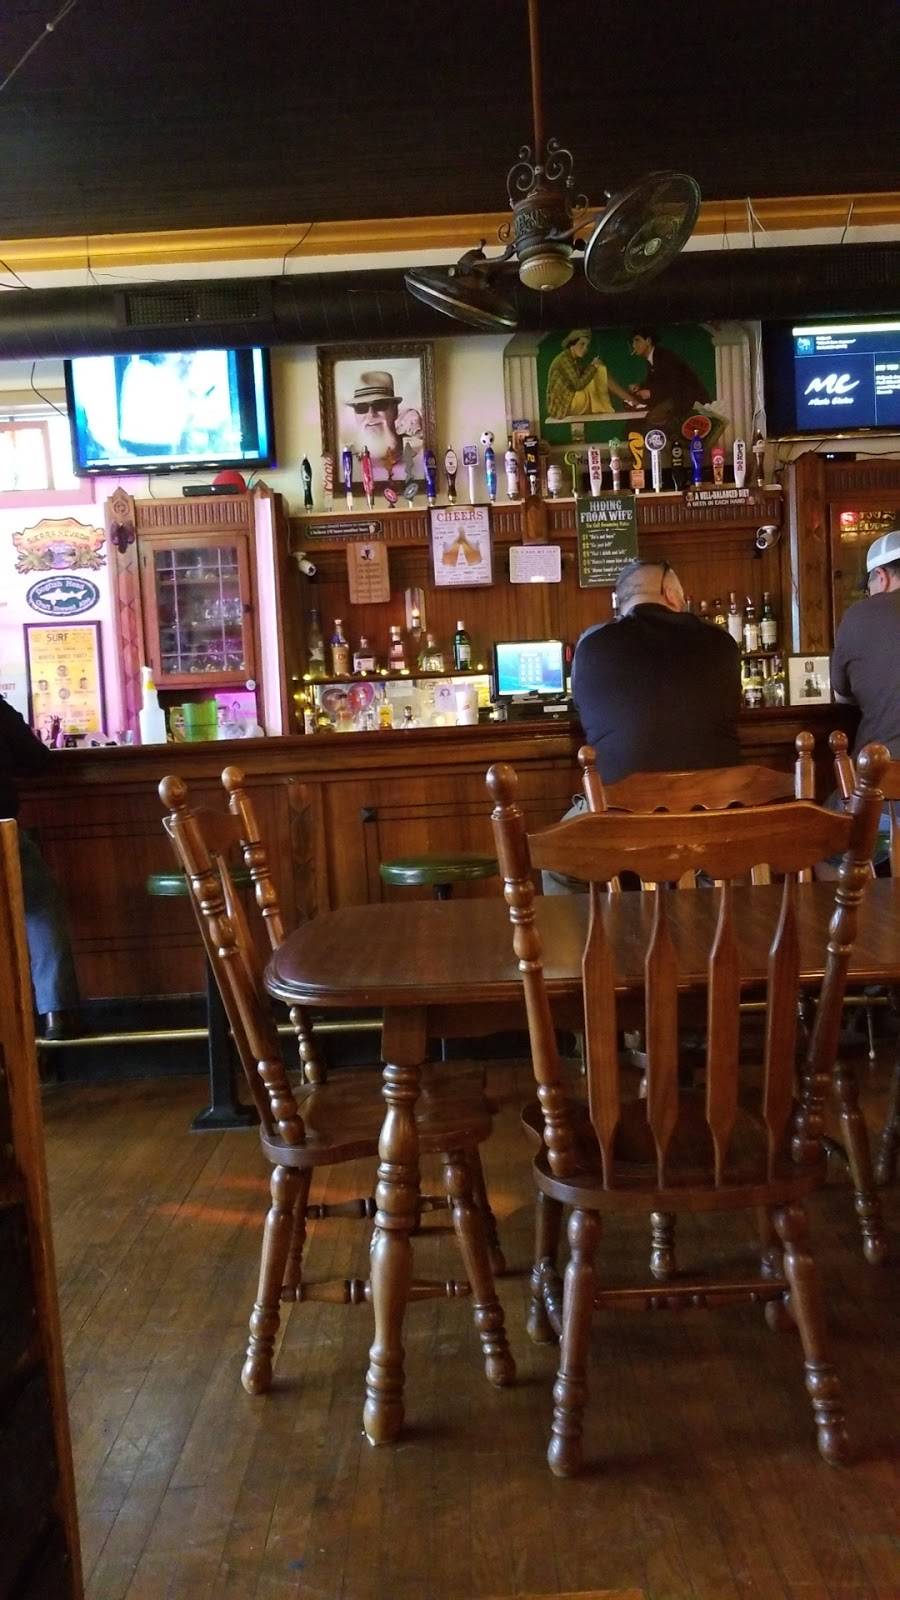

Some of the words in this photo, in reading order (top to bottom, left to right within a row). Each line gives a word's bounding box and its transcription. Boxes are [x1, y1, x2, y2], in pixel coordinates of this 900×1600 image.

[589, 500, 622, 512] HIDING
[436, 511, 484, 522] CHEERS
[580, 511, 607, 523] FROM
[608, 509, 633, 521] WIFE
[46, 632, 69, 642] SURF
